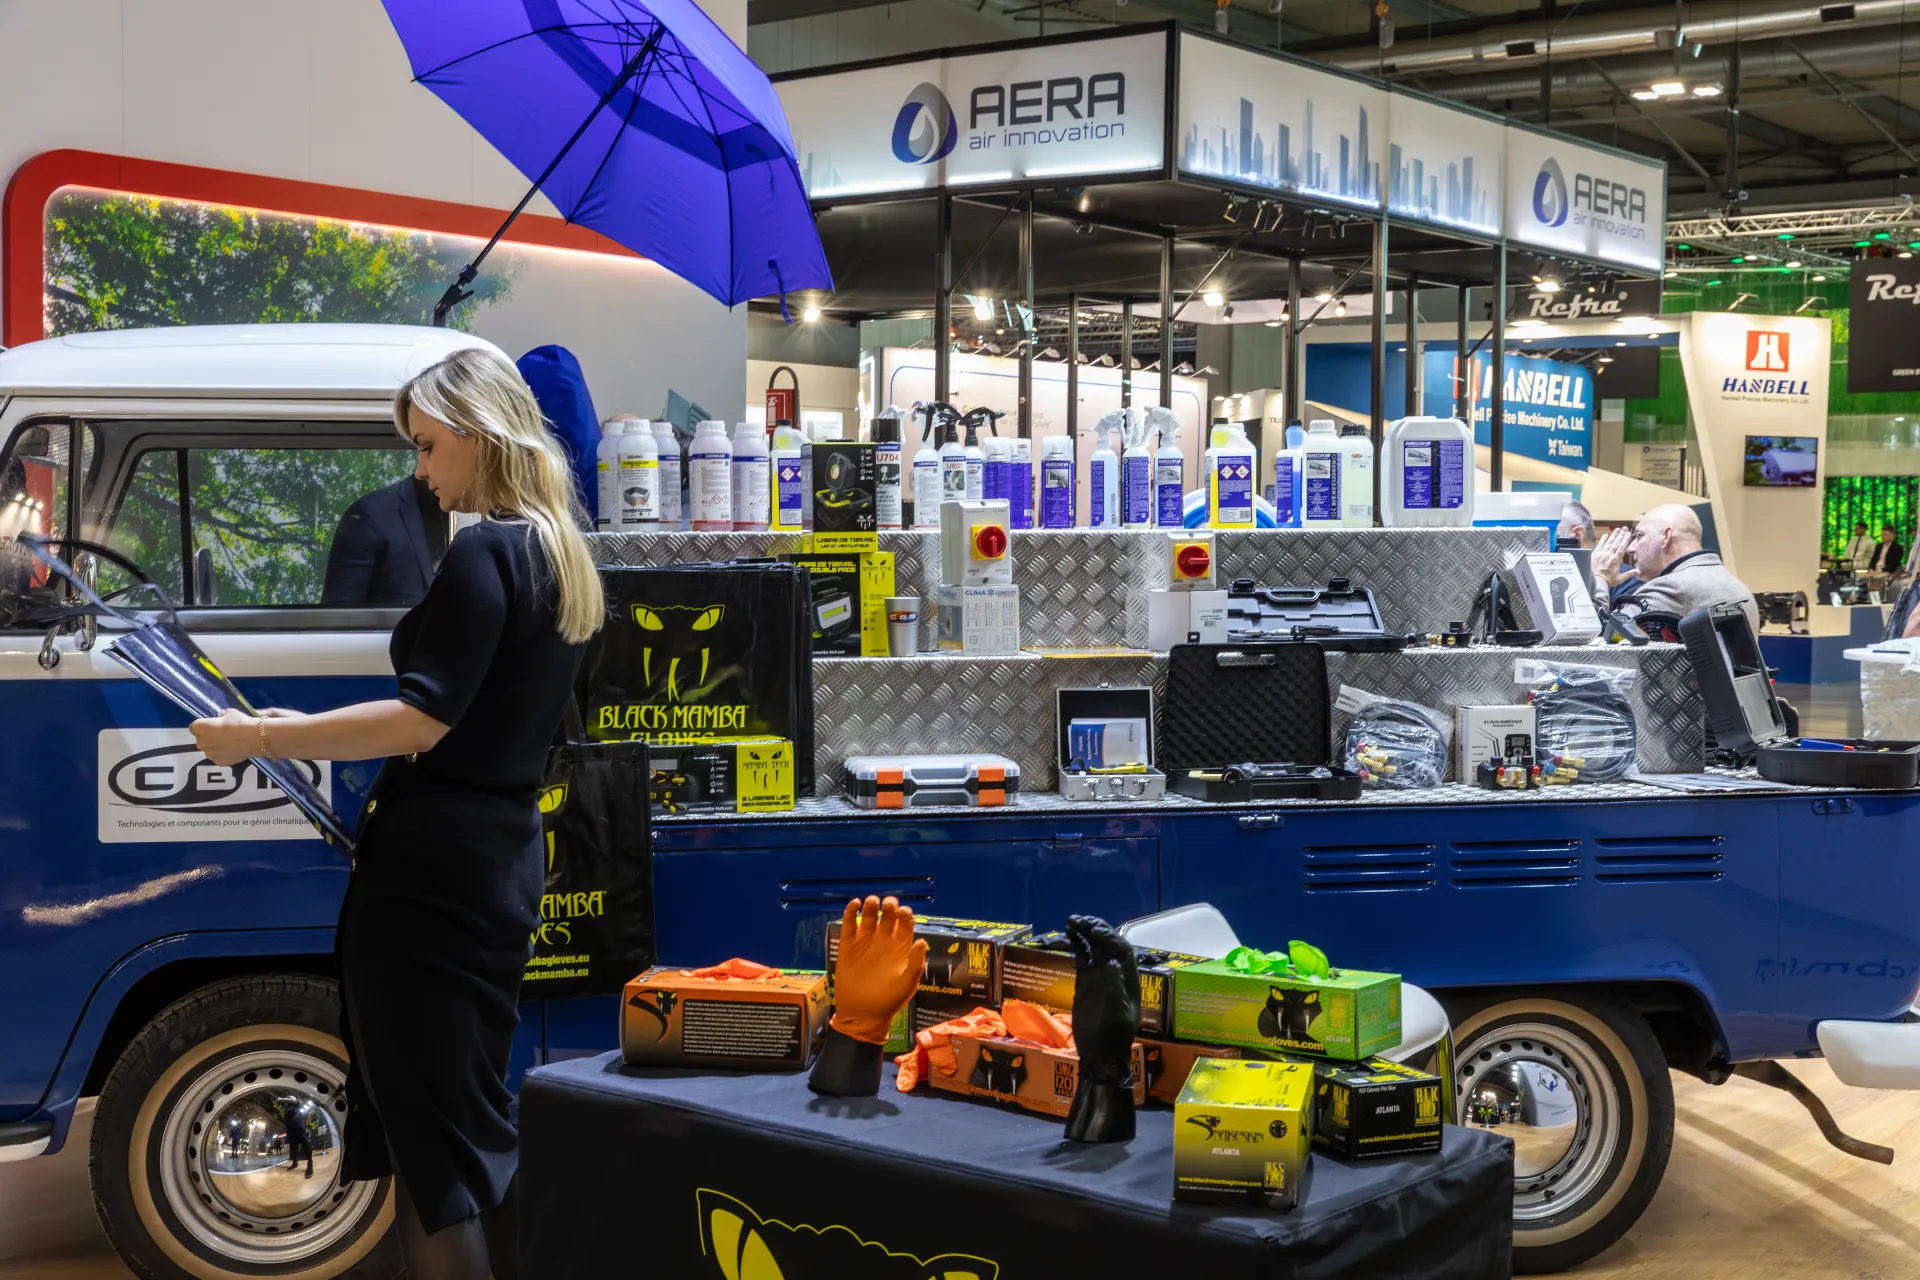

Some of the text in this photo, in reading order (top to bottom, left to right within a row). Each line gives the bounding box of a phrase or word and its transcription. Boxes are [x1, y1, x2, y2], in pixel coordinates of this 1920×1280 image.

[970, 71, 1125, 129] AERA
[969, 122, 1125, 151] air innovation
[1574, 173, 1646, 224] AERA
[1573, 213, 1646, 240] air innovation
[1722, 377, 1810, 395] HANBELL
[1518, 410, 1556, 432] Machinery
[1557, 415, 1570, 430] Co.
[599, 704, 747, 730] BLACK MAMBA
[743, 761, 768, 770] MAMBA
[117, 819, 166, 829] Technologies
[176, 820, 222, 829] composants
[250, 818, 271, 828] génie
[540, 891, 604, 919] AMBA
[531, 922, 572, 946] VES
[968, 943, 990, 957] BLK
[523, 969, 589, 981] ackmamba.eu
[1179, 1026, 1324, 1051] www.blackmambagloves.com
[1326, 1035, 1351, 1044] ATLANTA
[1416, 1086, 1439, 1104] BLK
[1376, 1105, 1400, 1115] ATLANTA
[1415, 1116, 1439, 1125] MEDIUM
[1359, 1131, 1439, 1144] www.blackmambagloves.com
[1212, 1147, 1240, 1156] ATLANTA
[1178, 1177, 1263, 1188] www.blackmambagloves.com
